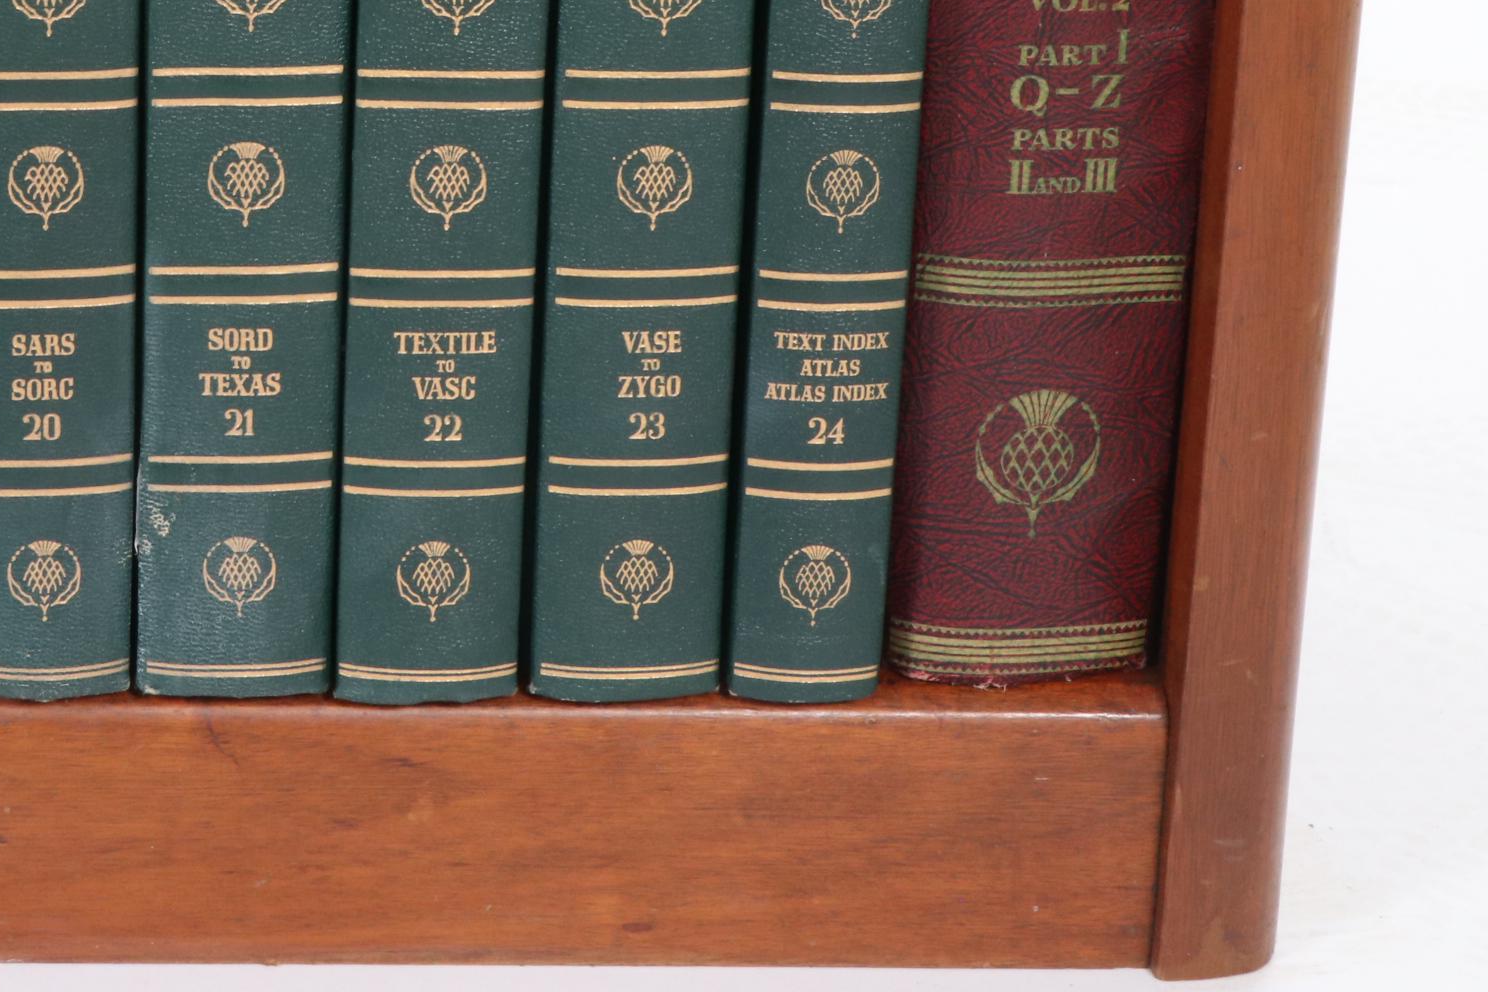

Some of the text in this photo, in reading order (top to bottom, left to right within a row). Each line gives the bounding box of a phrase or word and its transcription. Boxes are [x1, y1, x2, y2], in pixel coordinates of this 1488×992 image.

[1018, 28, 1130, 66] PART I
[1012, 127, 1120, 151] PARTS
[12, 333, 75, 356] SARS
[208, 328, 273, 351] SORD
[394, 331, 496, 354] TEXTILE
[622, 331, 682, 353] VASE
[774, 331, 889, 350] TEXT INDEX
[34, 361, 52, 374] TO
[231, 356, 251, 369] TO
[436, 359, 455, 373] TO
[641, 358, 660, 371] TO
[800, 359, 860, 377] ATLAS
[199, 372, 281, 396] TEXAS
[618, 375, 681, 398] ZYGO
[765, 383, 888, 402] ATLAS INDEX
[23, 413, 61, 440] 20
[224, 409, 254, 436] 21
[424, 414, 462, 441] 22
[629, 412, 665, 439] 23
[808, 417, 844, 444] 24
